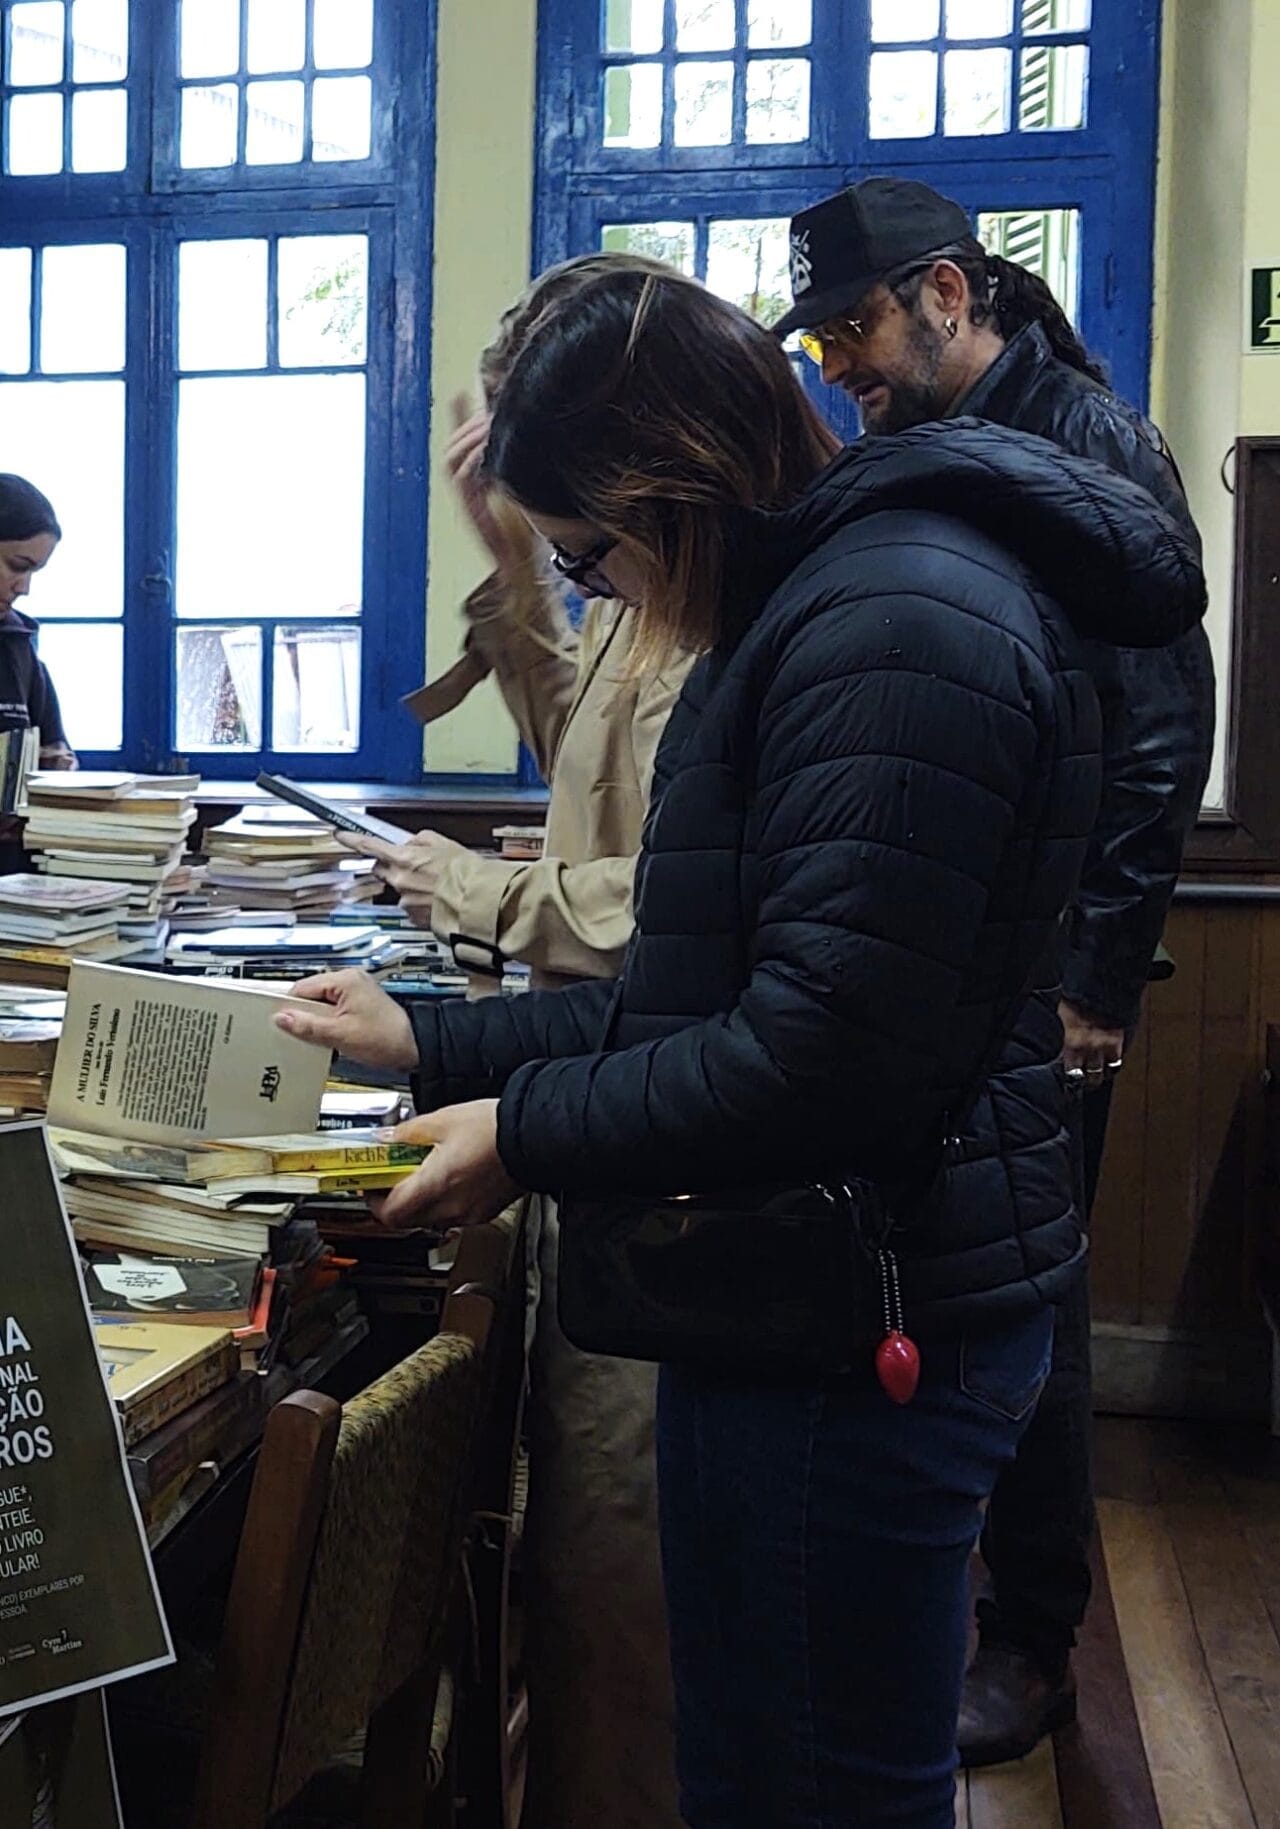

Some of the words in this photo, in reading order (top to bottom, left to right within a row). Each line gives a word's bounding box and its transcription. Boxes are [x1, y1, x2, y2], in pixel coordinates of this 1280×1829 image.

[89, 1003, 101, 1031] SILVA
[86, 1032, 96, 1048] DO
[77, 1050, 93, 1092] MULHER
[5, 1528, 44, 1553] LIVRO
